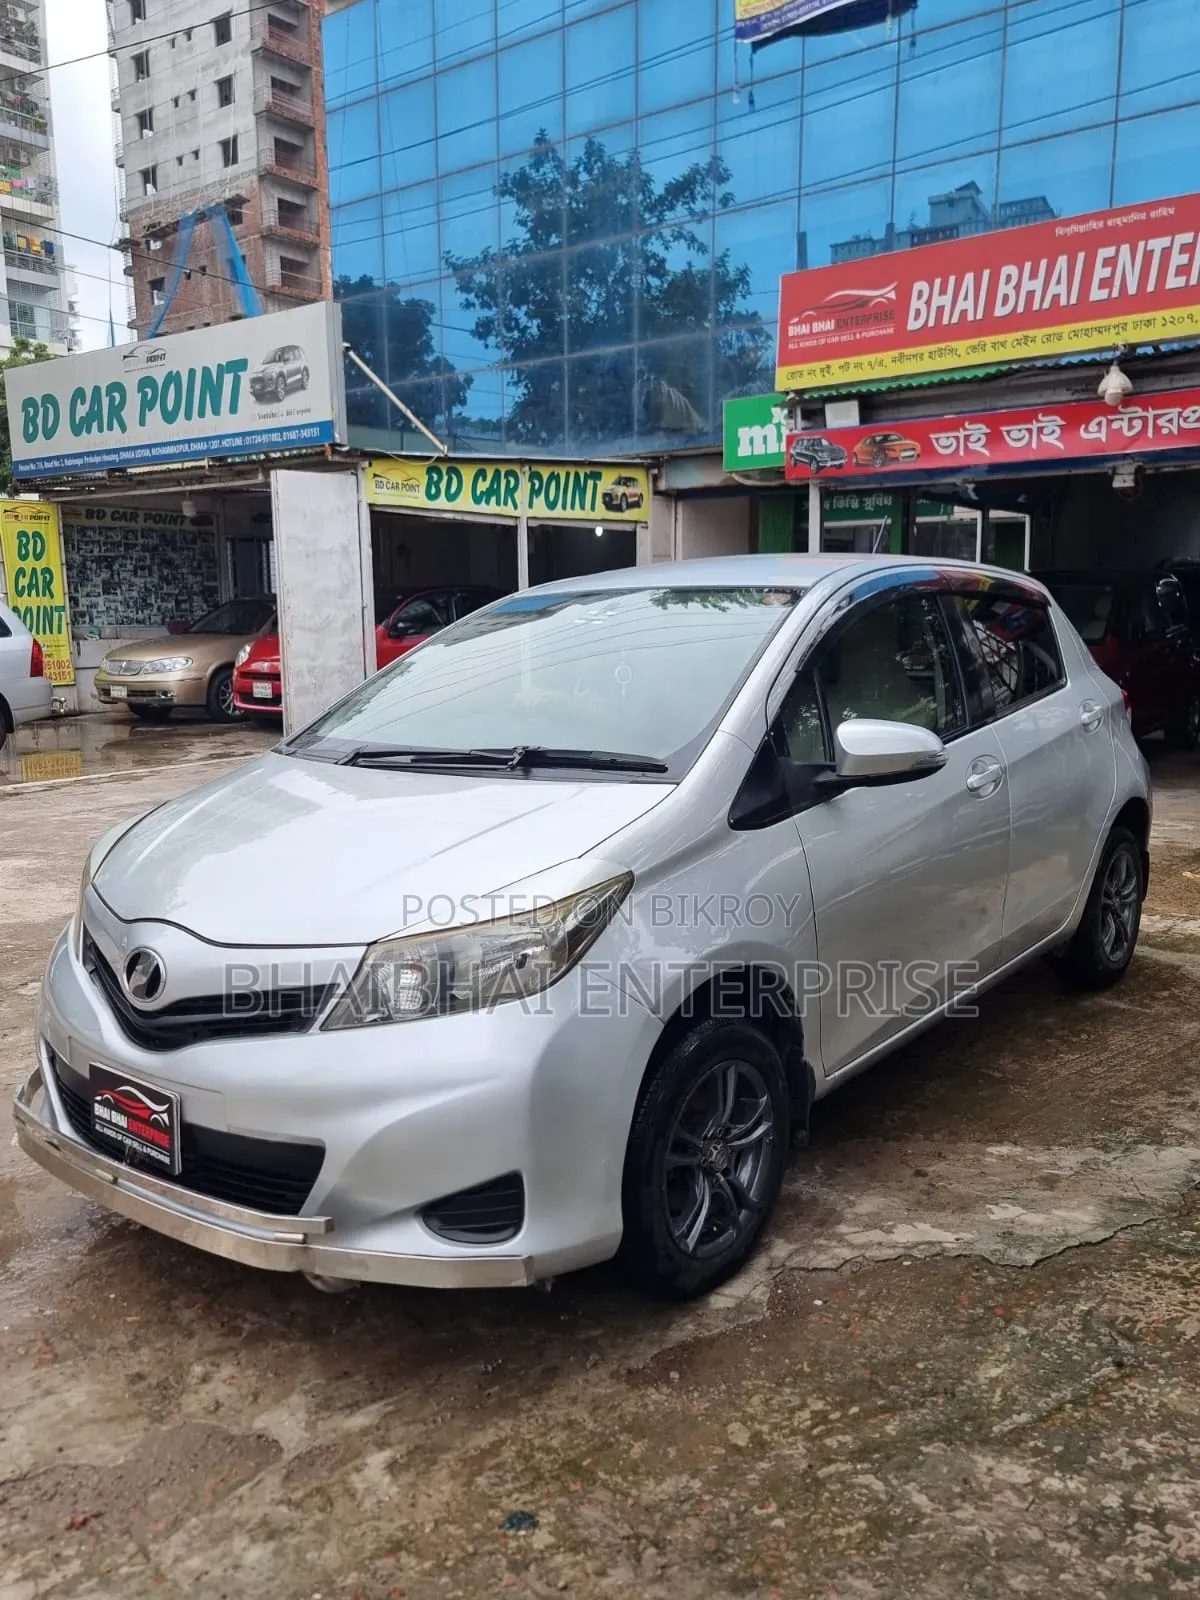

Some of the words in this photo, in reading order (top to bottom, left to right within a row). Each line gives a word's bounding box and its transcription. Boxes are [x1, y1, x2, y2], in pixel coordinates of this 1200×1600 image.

[907, 269, 990, 332] BHAI
[998, 251, 1085, 316] BHAI
[788, 322, 810, 337] BHAI
[812, 318, 835, 334] BHAI
[837, 310, 895, 328] ENTERPRISE
[1041, 331, 1064, 345] রোড
[1132, 317, 1157, 331] ঢাকা
[146, 353, 167, 364] POINT
[22, 392, 60, 443] BD
[69, 381, 127, 437] CAR
[137, 358, 249, 426] POINT
[929, 420, 992, 457] ভাই
[1000, 412, 1067, 450] ভাই
[374, 479, 385, 490] BD
[386, 481, 400, 492] CAR
[401, 482, 420, 494] POINT
[424, 465, 463, 502] BD
[471, 467, 521, 512] CAR
[528, 470, 603, 513] POINT
[85, 508, 107, 520] BD
[110, 510, 140, 523] CAR
[144, 512, 186, 526] POINT
[16, 530, 46, 562] BD
[14, 566, 55, 599] CAR
